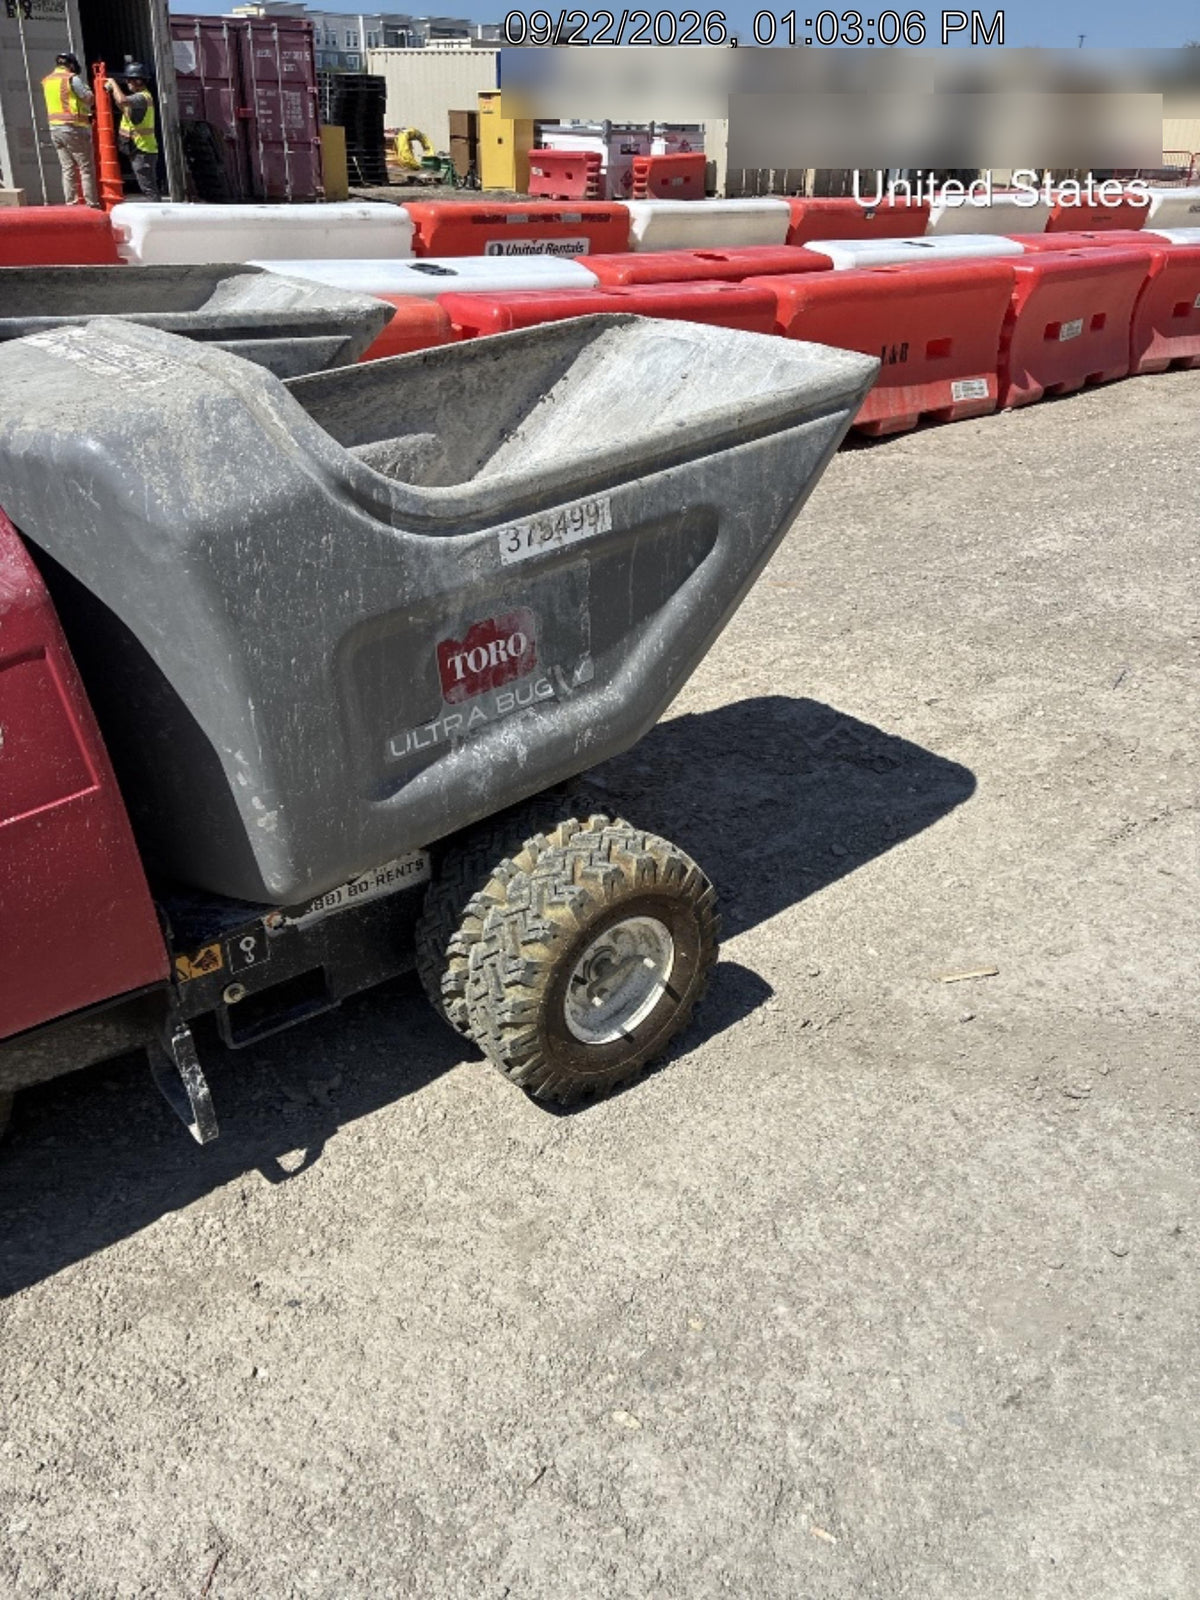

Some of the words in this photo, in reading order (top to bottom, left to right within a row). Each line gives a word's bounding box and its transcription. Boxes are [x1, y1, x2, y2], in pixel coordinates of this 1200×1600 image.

[506, 242, 543, 256] United
[545, 241, 584, 255] Rentals
[447, 632, 527, 680] TORO
[390, 705, 487, 756] ULTRA
